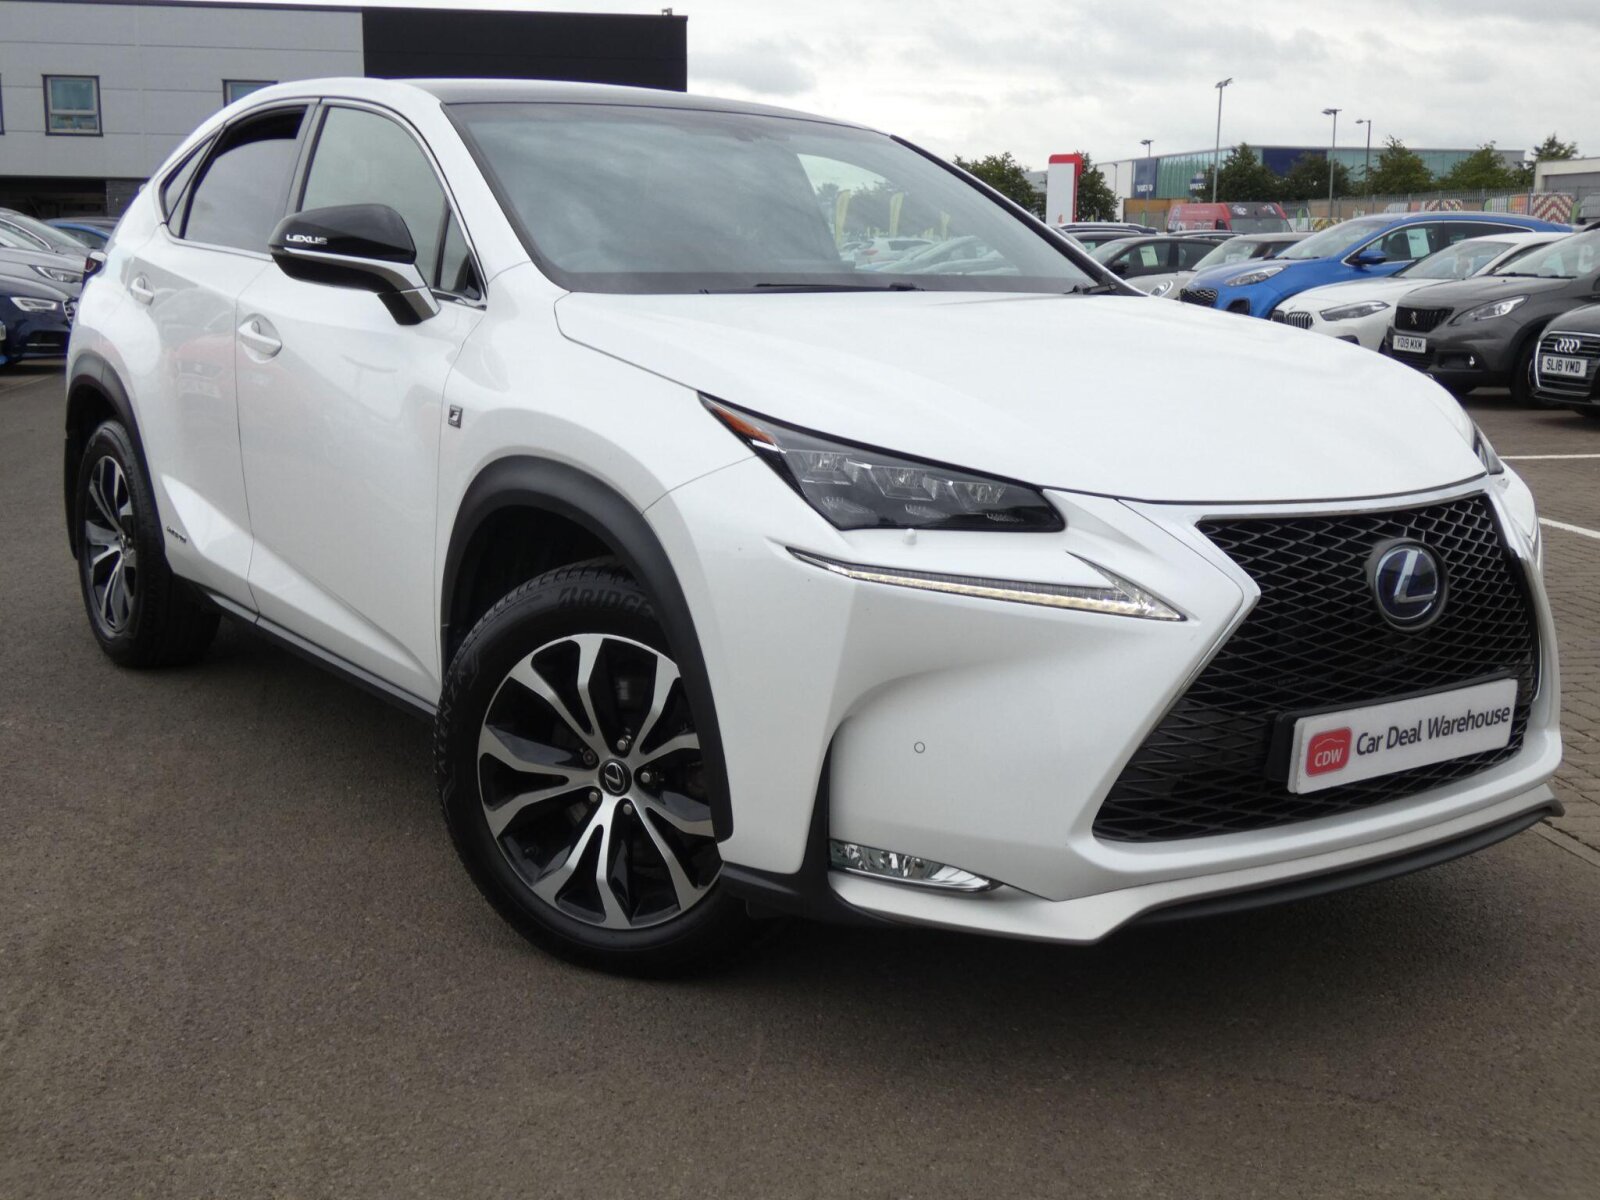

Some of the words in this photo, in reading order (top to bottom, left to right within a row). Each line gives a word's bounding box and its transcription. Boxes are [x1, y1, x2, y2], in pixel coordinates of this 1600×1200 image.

[286, 234, 328, 245] LEXUS
[1546, 358, 1562, 372] SL18
[1564, 361, 1581, 374] VMD
[1356, 732, 1384, 756] Car
[1386, 720, 1422, 750] Deal
[1427, 705, 1511, 739] Warehouse
[1314, 747, 1344, 768] CDW
